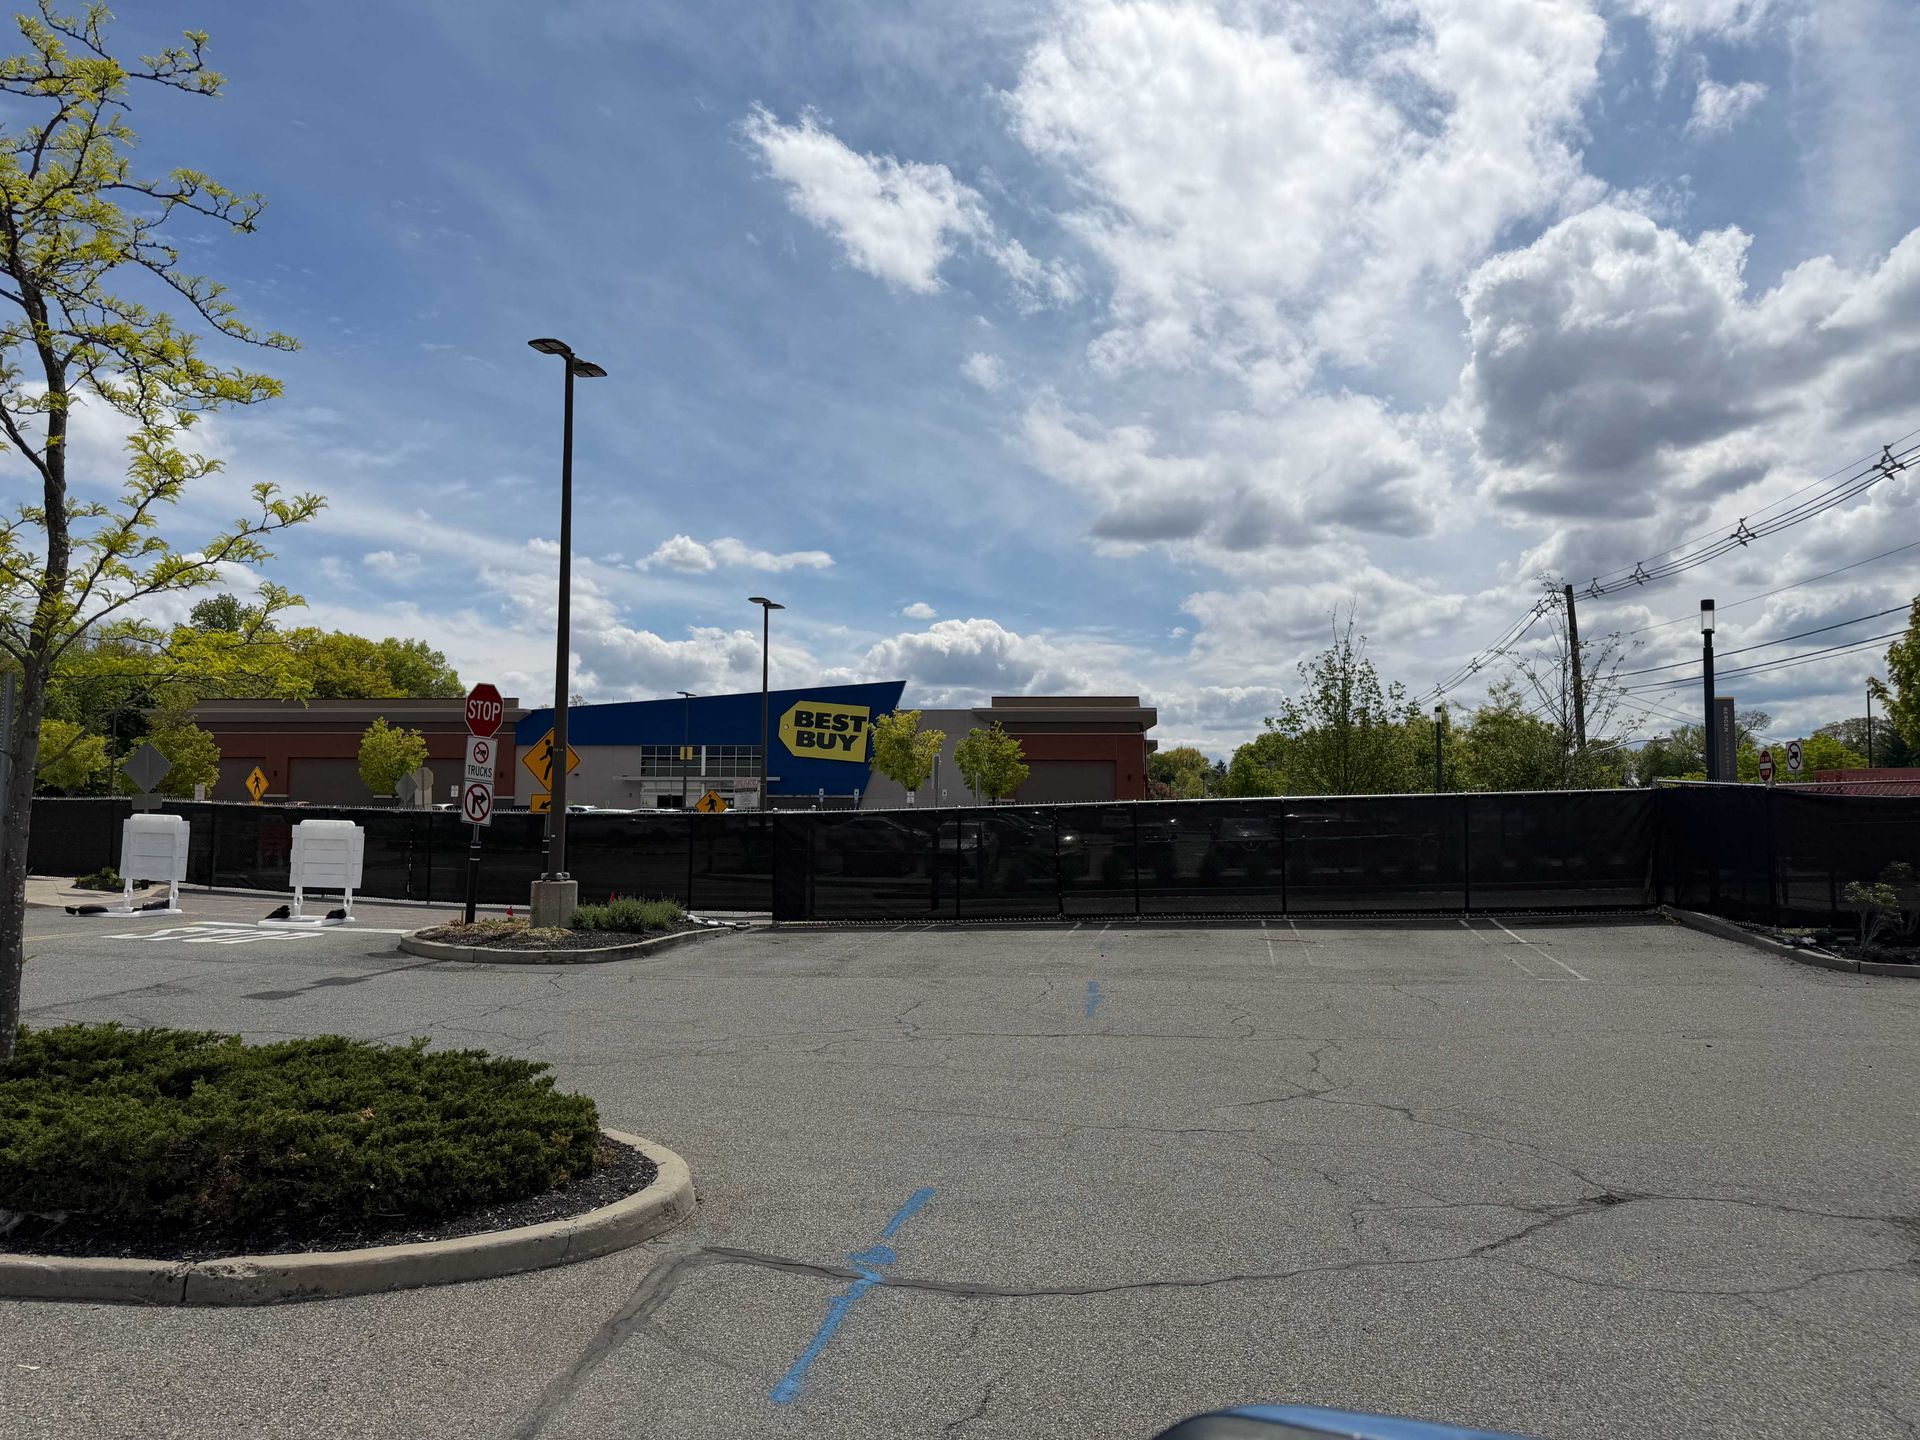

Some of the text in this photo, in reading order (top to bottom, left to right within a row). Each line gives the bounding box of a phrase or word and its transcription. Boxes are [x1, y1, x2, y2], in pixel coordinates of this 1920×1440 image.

[468, 700, 501, 721] STOP
[794, 710, 867, 732] BEST
[795, 730, 859, 751] BUY
[467, 765, 492, 778] TRUCKS
[101, 927, 325, 944] STOP
